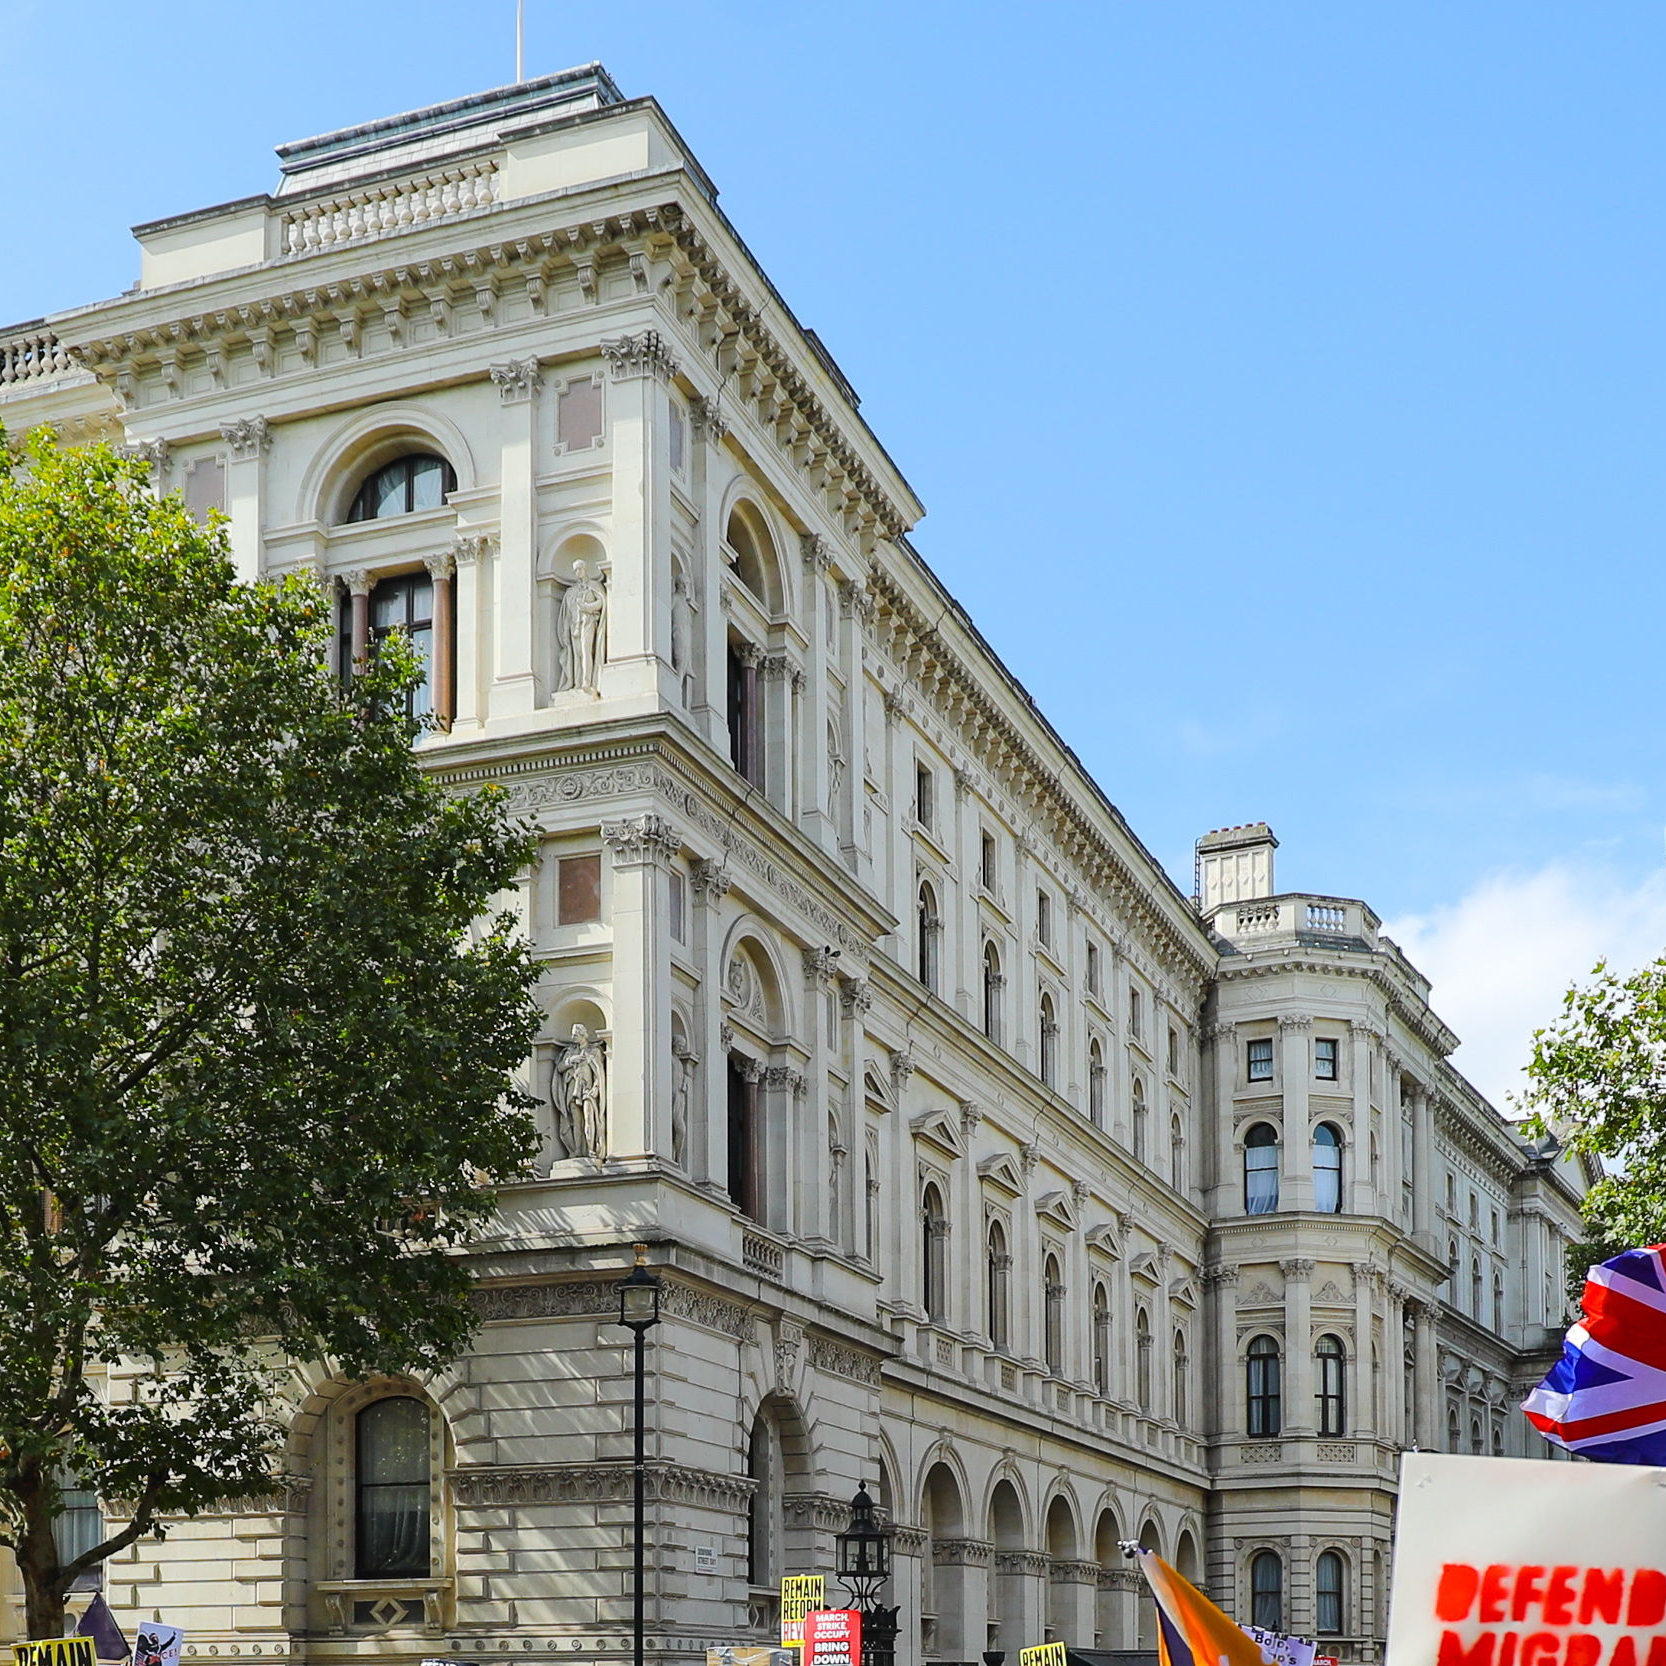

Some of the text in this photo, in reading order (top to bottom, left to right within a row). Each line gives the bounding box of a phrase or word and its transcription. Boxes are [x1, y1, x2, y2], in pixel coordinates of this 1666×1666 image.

[785, 1578, 822, 1599] REMAIN
[814, 1630, 850, 1639] OCCUPY
[815, 1642, 849, 1652] BRING
[814, 1654, 850, 1665] DOWN
